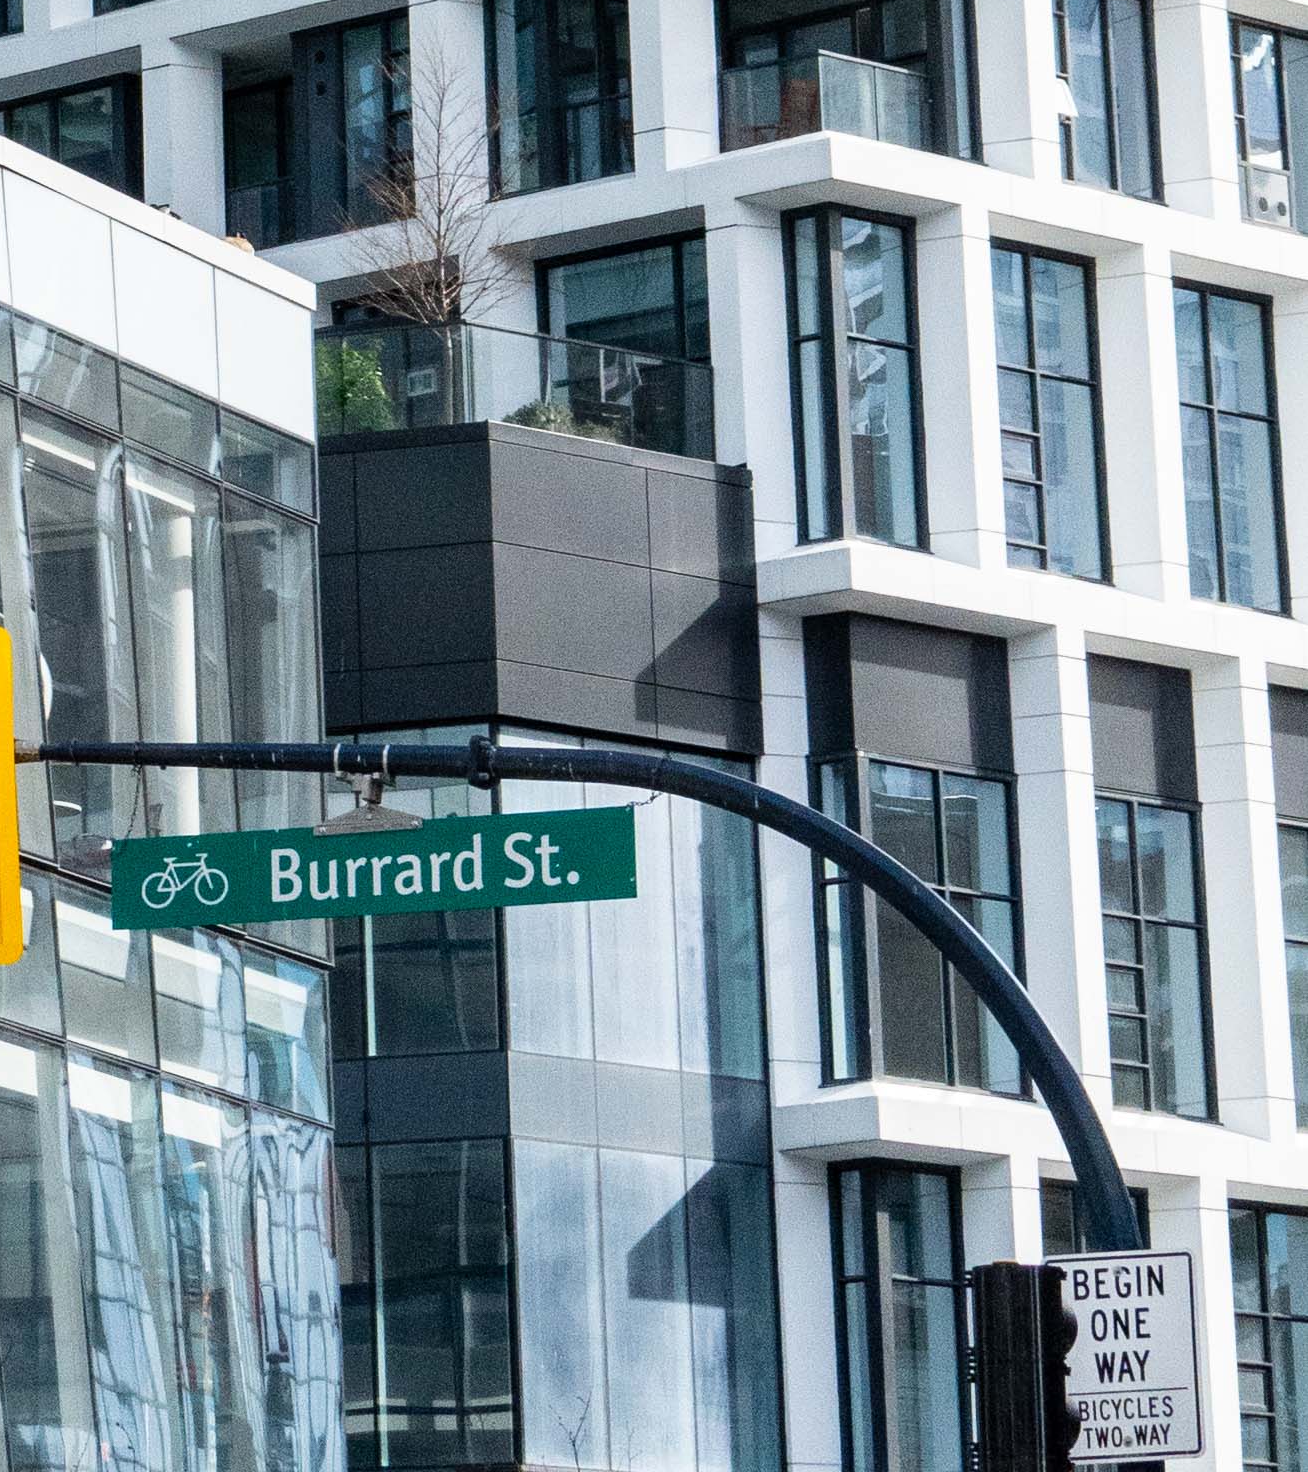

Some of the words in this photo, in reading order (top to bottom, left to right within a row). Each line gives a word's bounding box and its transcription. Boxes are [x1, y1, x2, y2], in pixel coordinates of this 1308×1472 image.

[271, 833, 485, 904] Burrard
[504, 831, 581, 889] St.
[1073, 1264, 1164, 1301] BEGIN
[1091, 1307, 1151, 1342] ONE
[1094, 1349, 1150, 1384] WAY
[1078, 1395, 1174, 1422] BICYCLES
[1083, 1425, 1123, 1449] TWO
[1134, 1423, 1171, 1446] WAY
